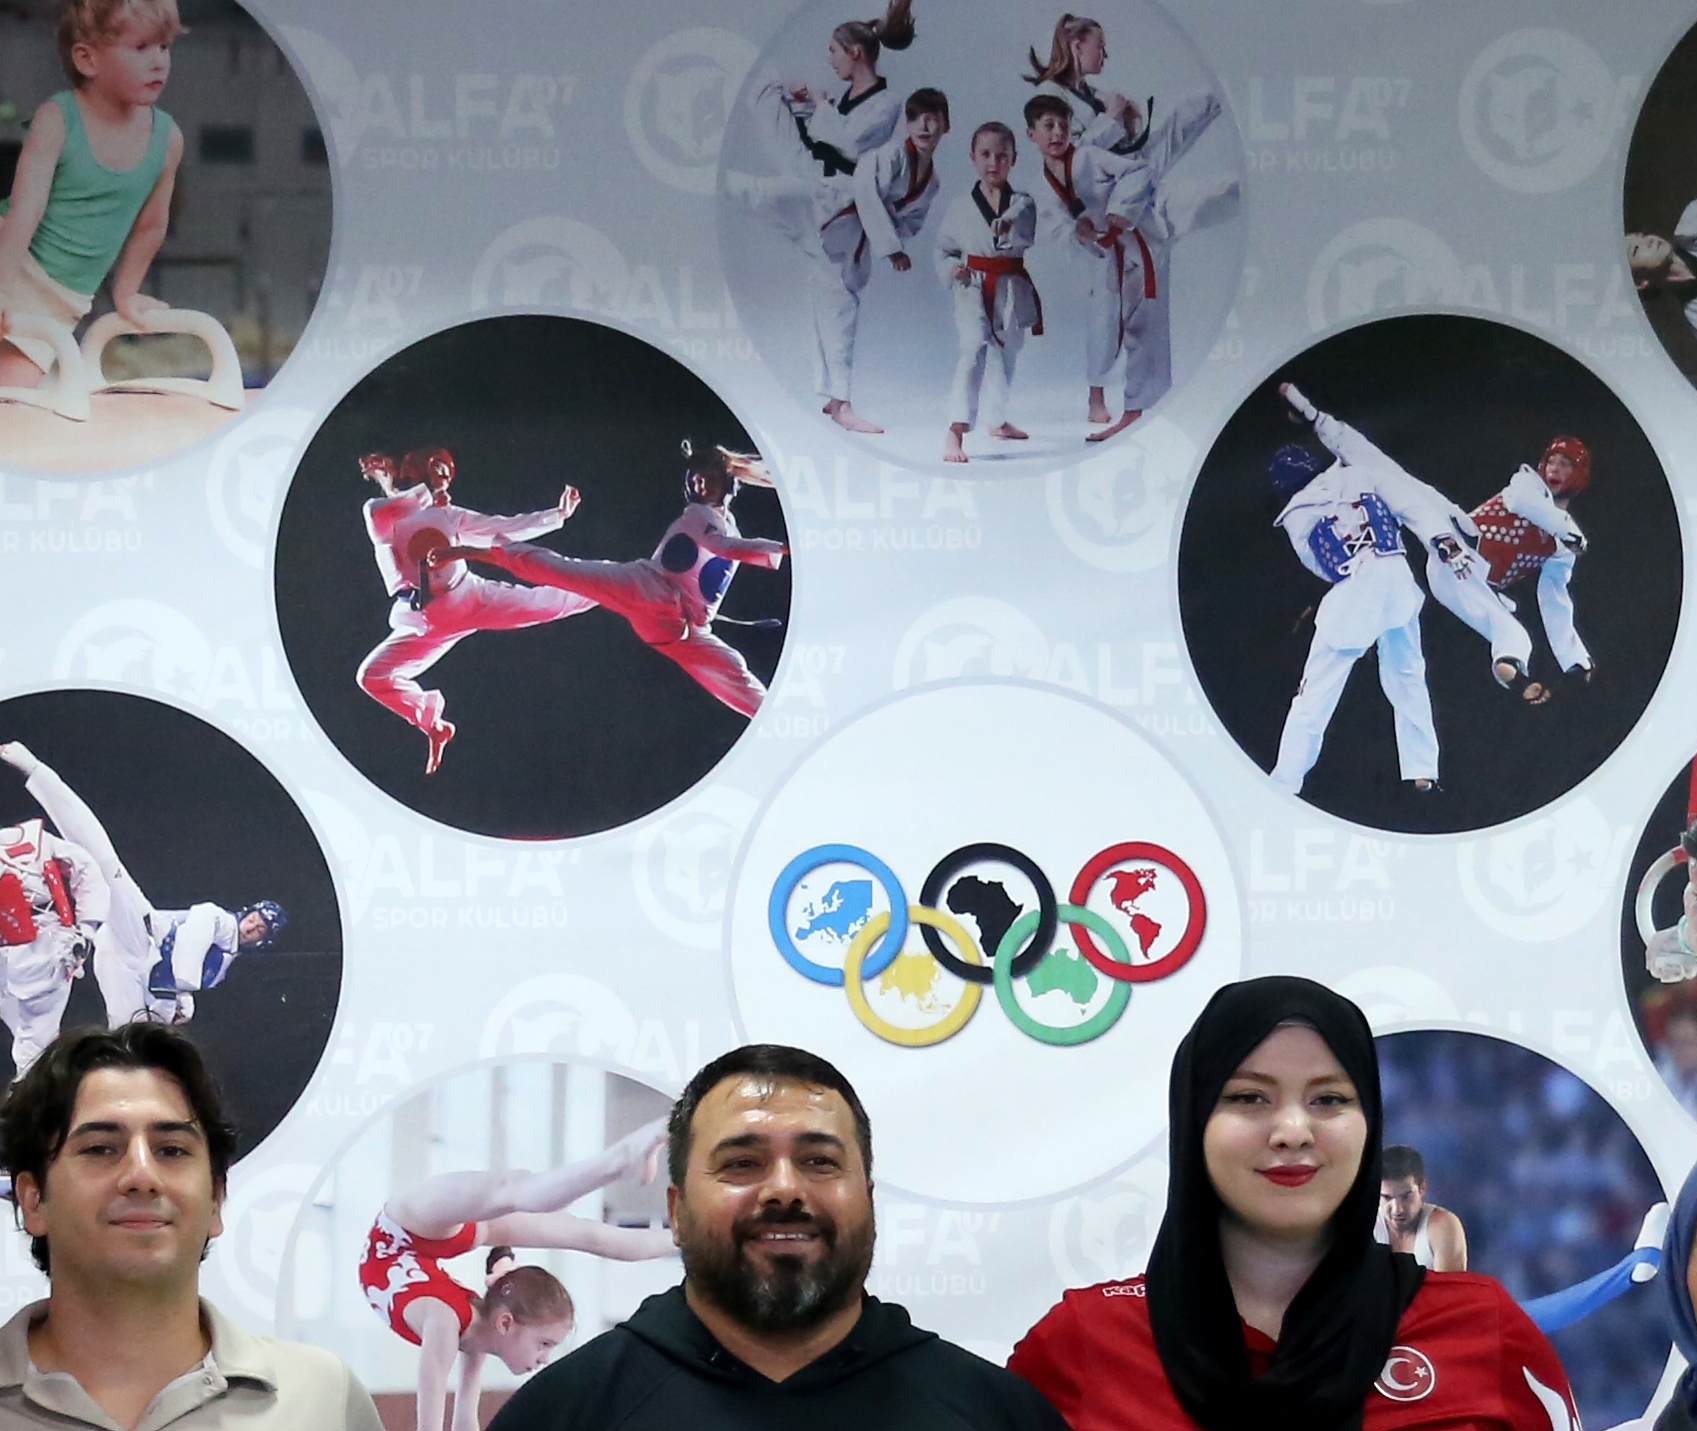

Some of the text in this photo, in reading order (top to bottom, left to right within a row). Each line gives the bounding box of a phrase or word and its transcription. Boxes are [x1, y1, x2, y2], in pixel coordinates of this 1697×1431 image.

[363, 148, 438, 170] SPOR
[29, 526, 142, 553] KULÜBÜ
[873, 525, 982, 550] KULÜBÜ
[371, 904, 568, 929] SPOR KULÜBÜ
